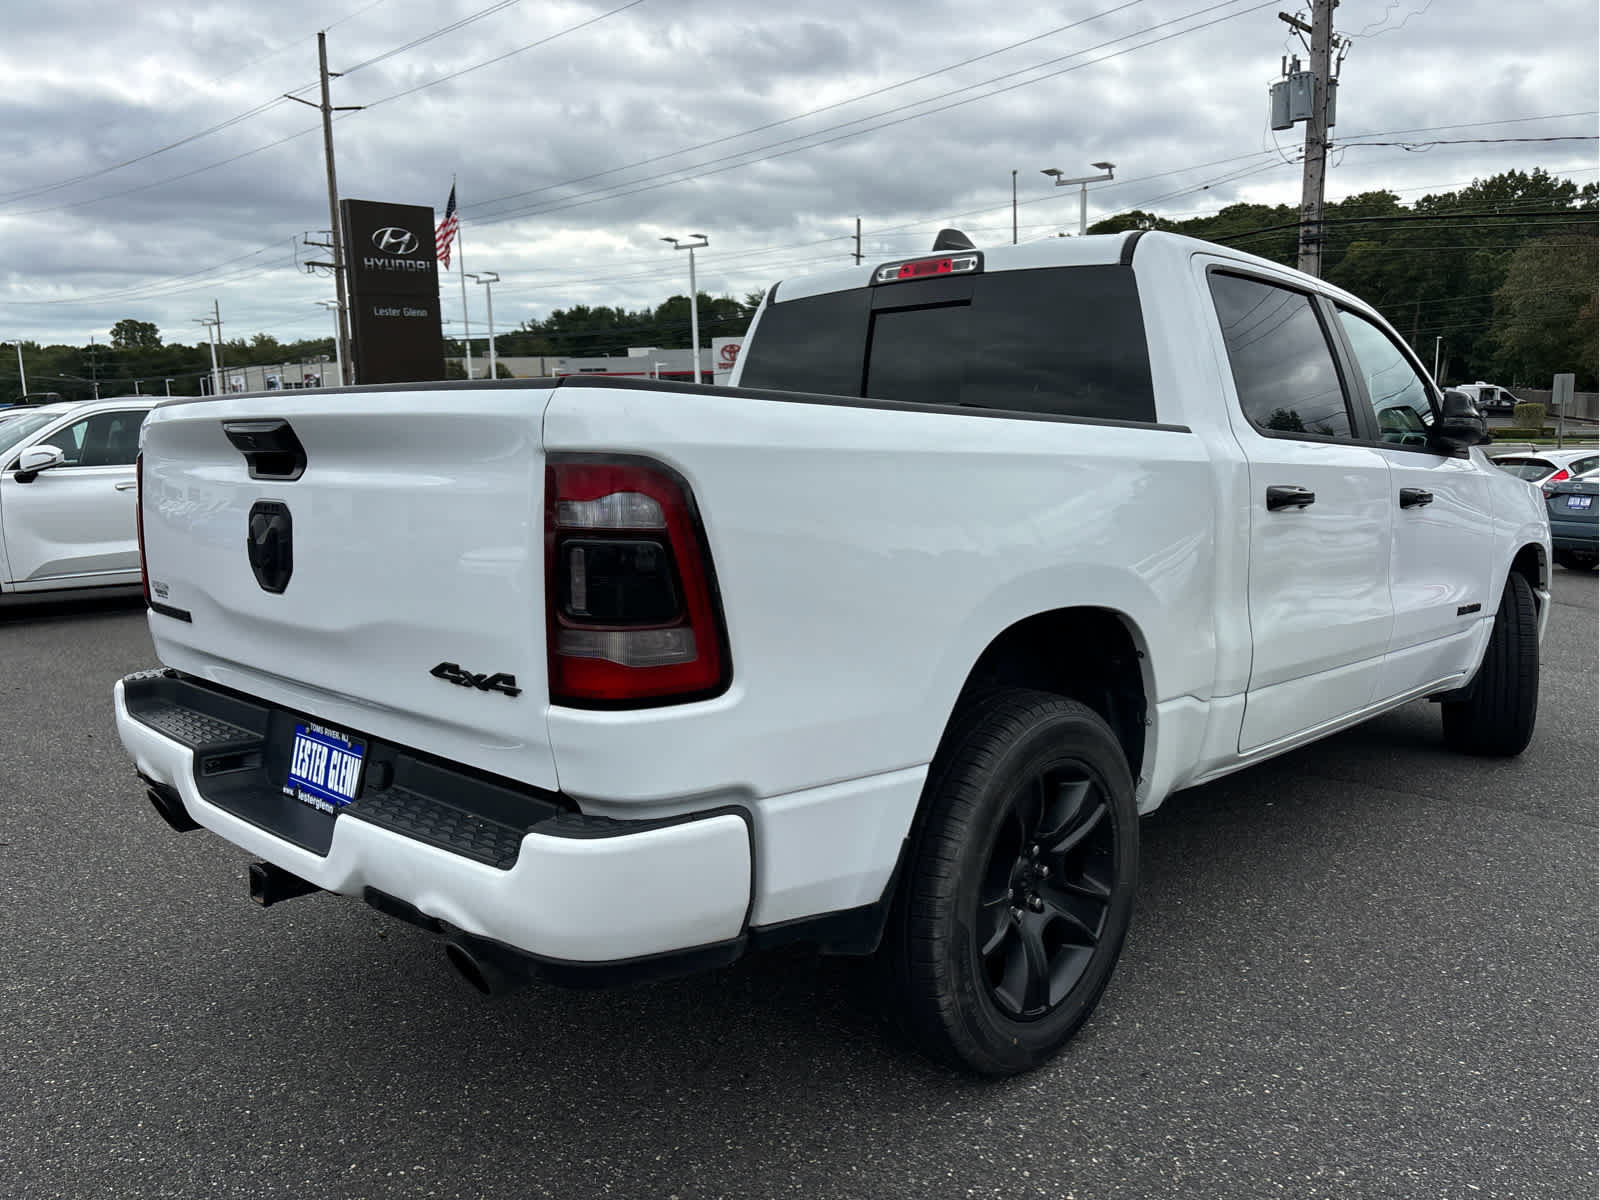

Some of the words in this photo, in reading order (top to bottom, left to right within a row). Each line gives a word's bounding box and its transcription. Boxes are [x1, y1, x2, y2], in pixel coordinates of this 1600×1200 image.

[363, 257, 431, 273] HYUNDAI
[373, 306, 401, 317] Lester
[402, 307, 428, 318] Glenn
[310, 722, 324, 735] TOMS
[341, 732, 349, 742] NJ
[290, 736, 328, 787] LESTER
[327, 749, 362, 799] GLENN
